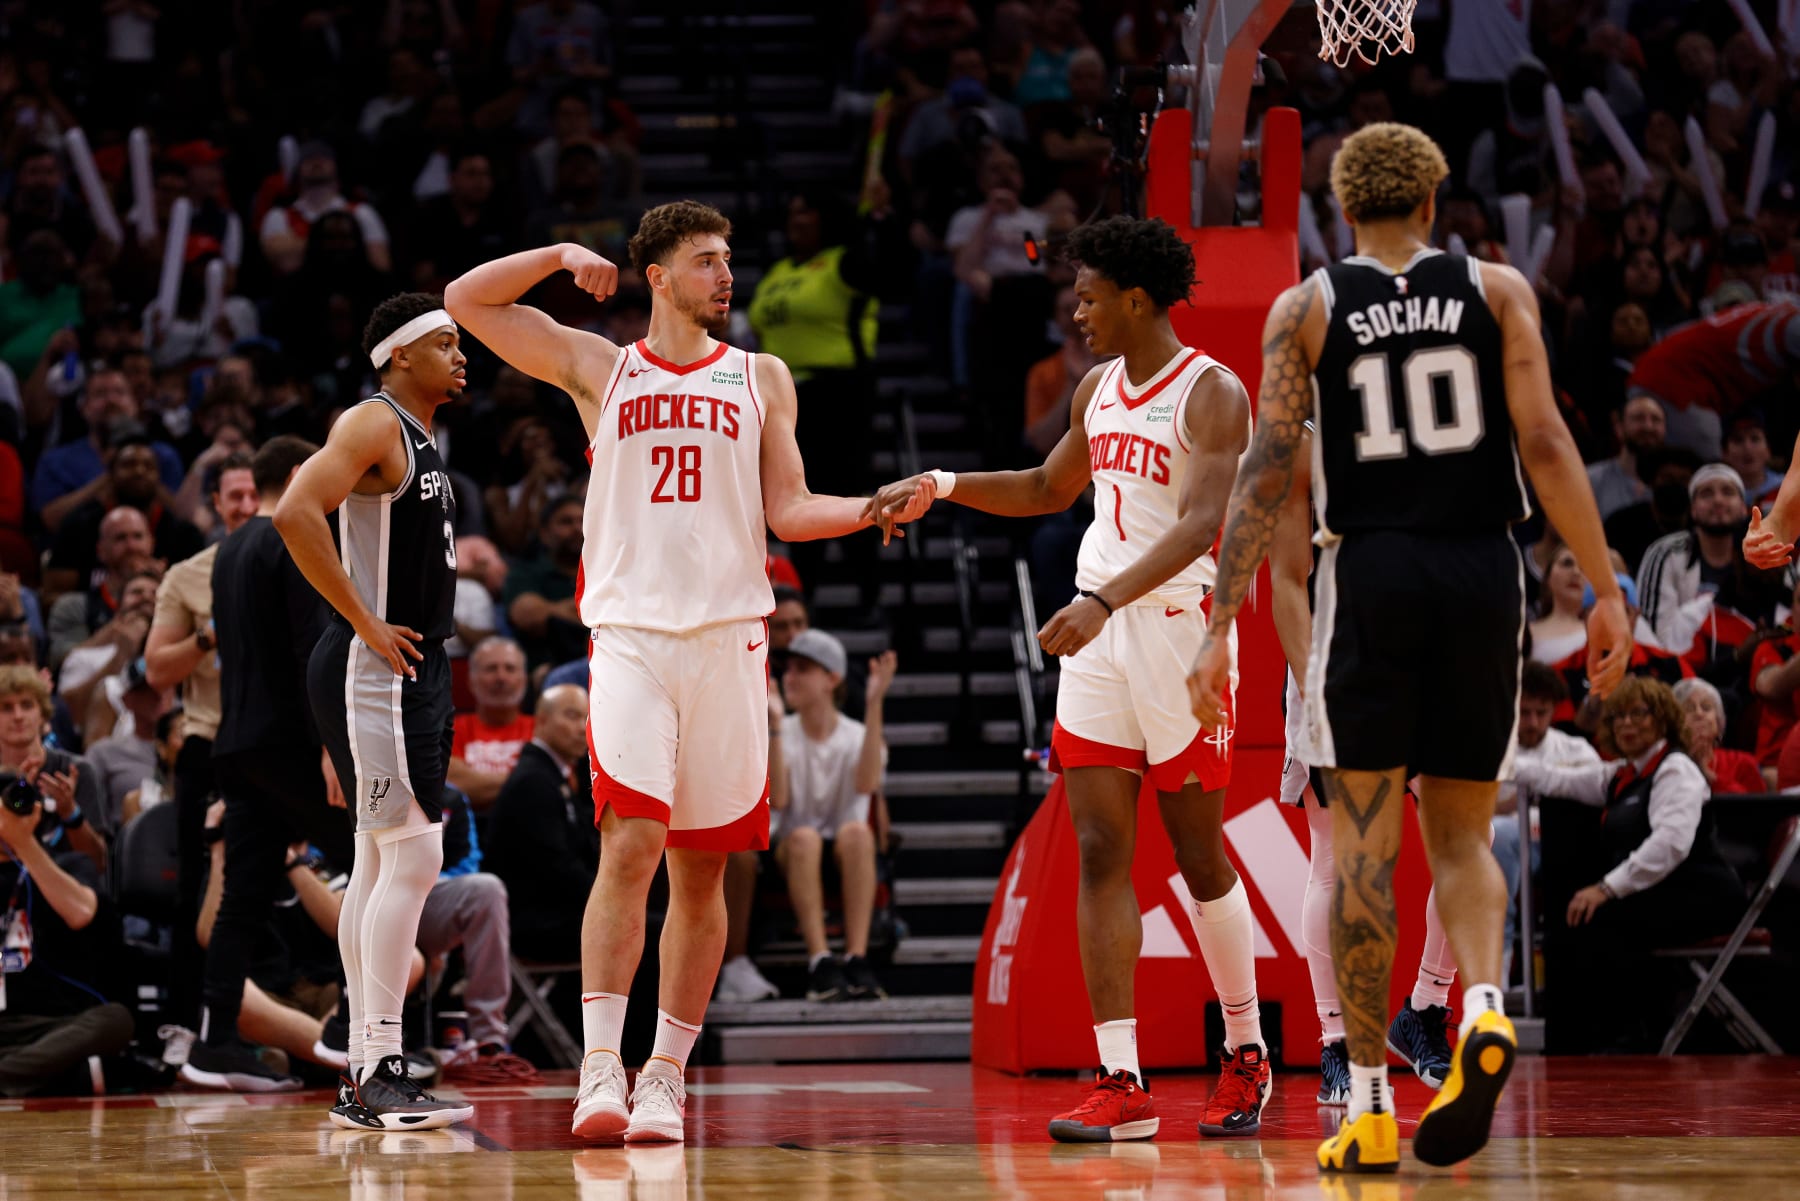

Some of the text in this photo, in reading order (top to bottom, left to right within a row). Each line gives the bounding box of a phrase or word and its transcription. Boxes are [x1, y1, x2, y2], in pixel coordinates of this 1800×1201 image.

[1346, 295, 1465, 346] SOCHAN
[711, 376, 744, 386] karma
[713, 370, 744, 379] credit
[618, 394, 740, 441] ROCKETS
[1146, 413, 1172, 422] karma
[1150, 404, 1175, 414] credit
[1346, 343, 1487, 463] 10
[650, 445, 702, 503] 28
[1113, 484, 1127, 541] 1
[443, 519, 457, 570] 3
